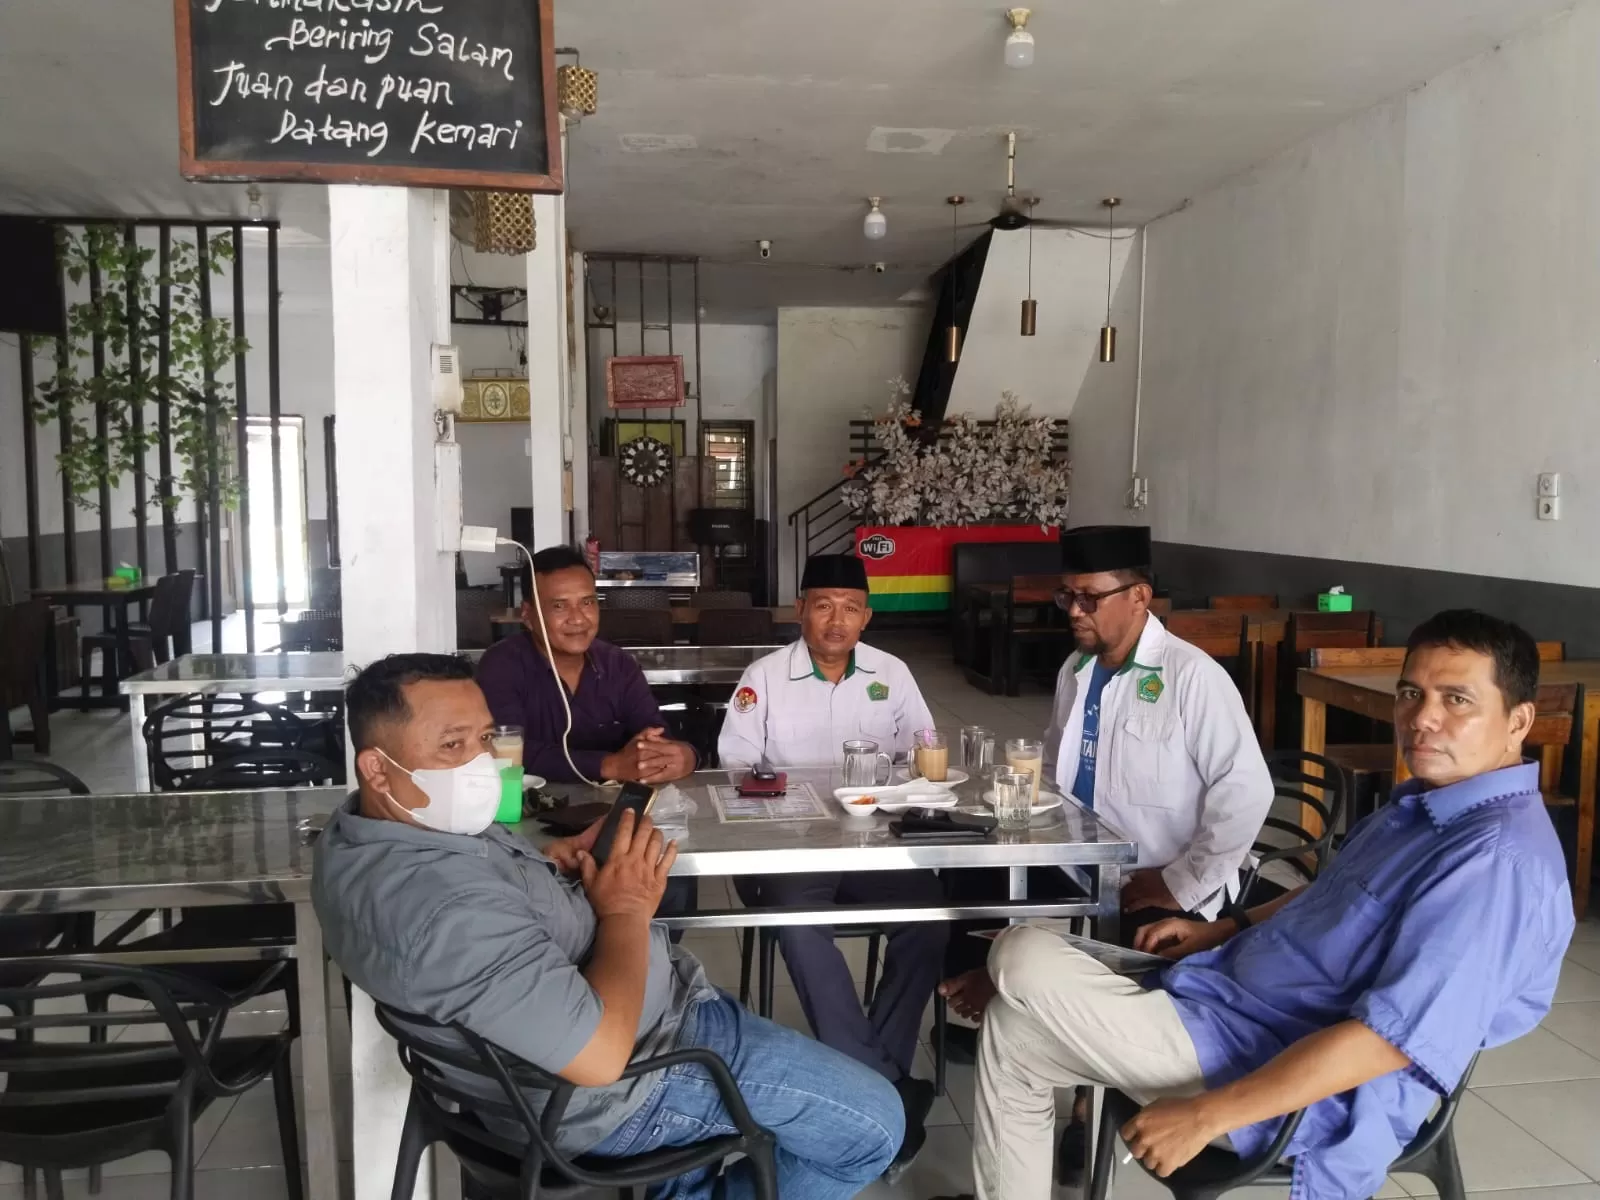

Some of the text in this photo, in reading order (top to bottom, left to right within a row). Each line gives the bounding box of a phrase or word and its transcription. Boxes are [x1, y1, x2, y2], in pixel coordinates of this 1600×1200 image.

[265, 18, 393, 64] Beriring
[304, 64, 367, 104] dan
[270, 109, 388, 157] Datang
